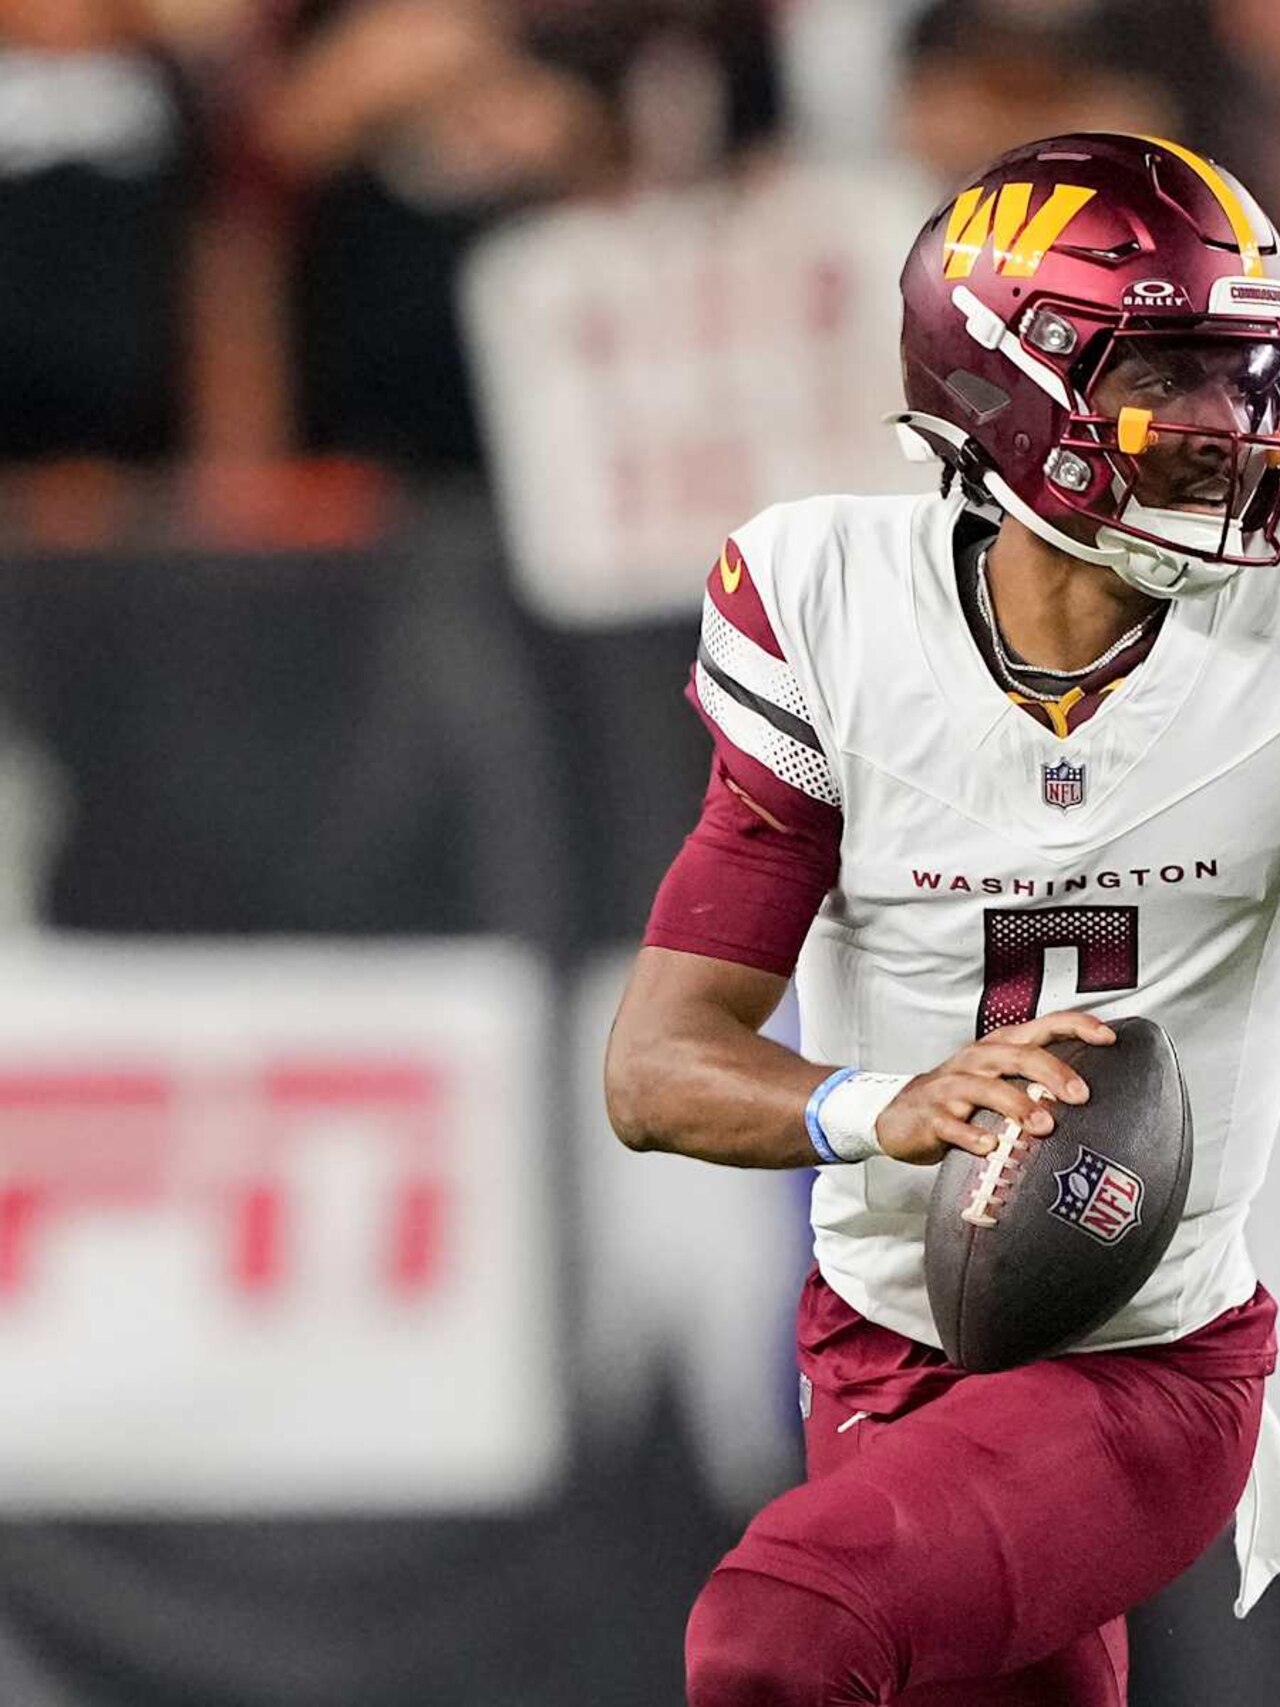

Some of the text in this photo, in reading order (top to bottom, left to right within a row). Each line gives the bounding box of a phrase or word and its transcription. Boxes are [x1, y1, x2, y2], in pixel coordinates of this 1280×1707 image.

[1123, 296, 1185, 307] OAKLEY
[1049, 783, 1080, 804] NFL
[911, 859, 1219, 897] WASHINGTON
[1082, 1175, 1137, 1238] NFL
